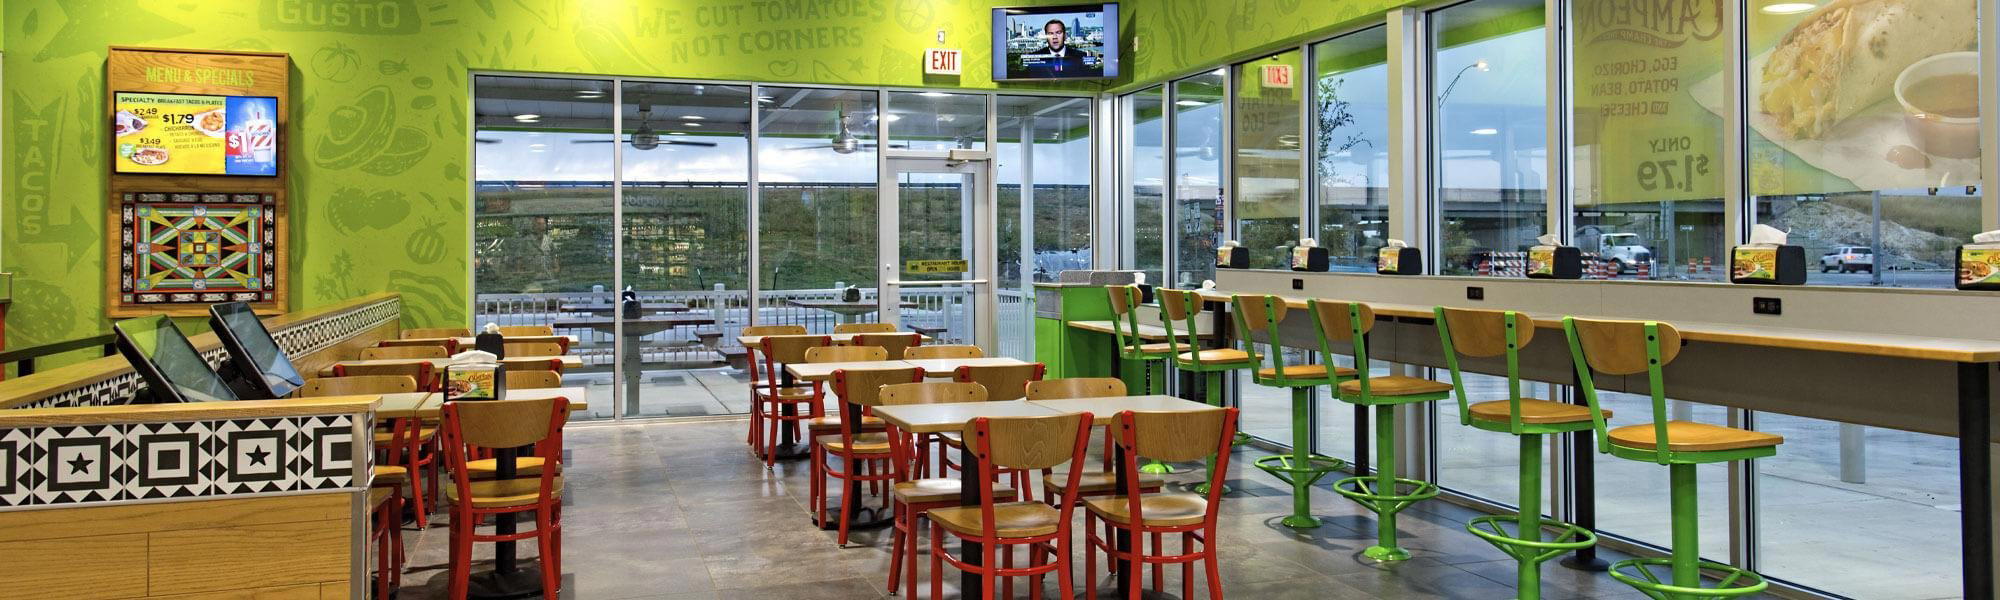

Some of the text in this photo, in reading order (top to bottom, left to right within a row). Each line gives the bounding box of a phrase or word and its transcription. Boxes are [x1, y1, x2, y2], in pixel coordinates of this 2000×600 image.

[277, 0, 400, 28] GUSTO
[631, 0, 887, 38] WE CUT TOMATOES
[671, 26, 863, 63] NOT CORNERS
[932, 50, 957, 71] EXIT
[145, 67, 255, 87] MENU & SPECIALS
[162, 113, 195, 125] $1.79
[20, 119, 49, 235] TACOS
